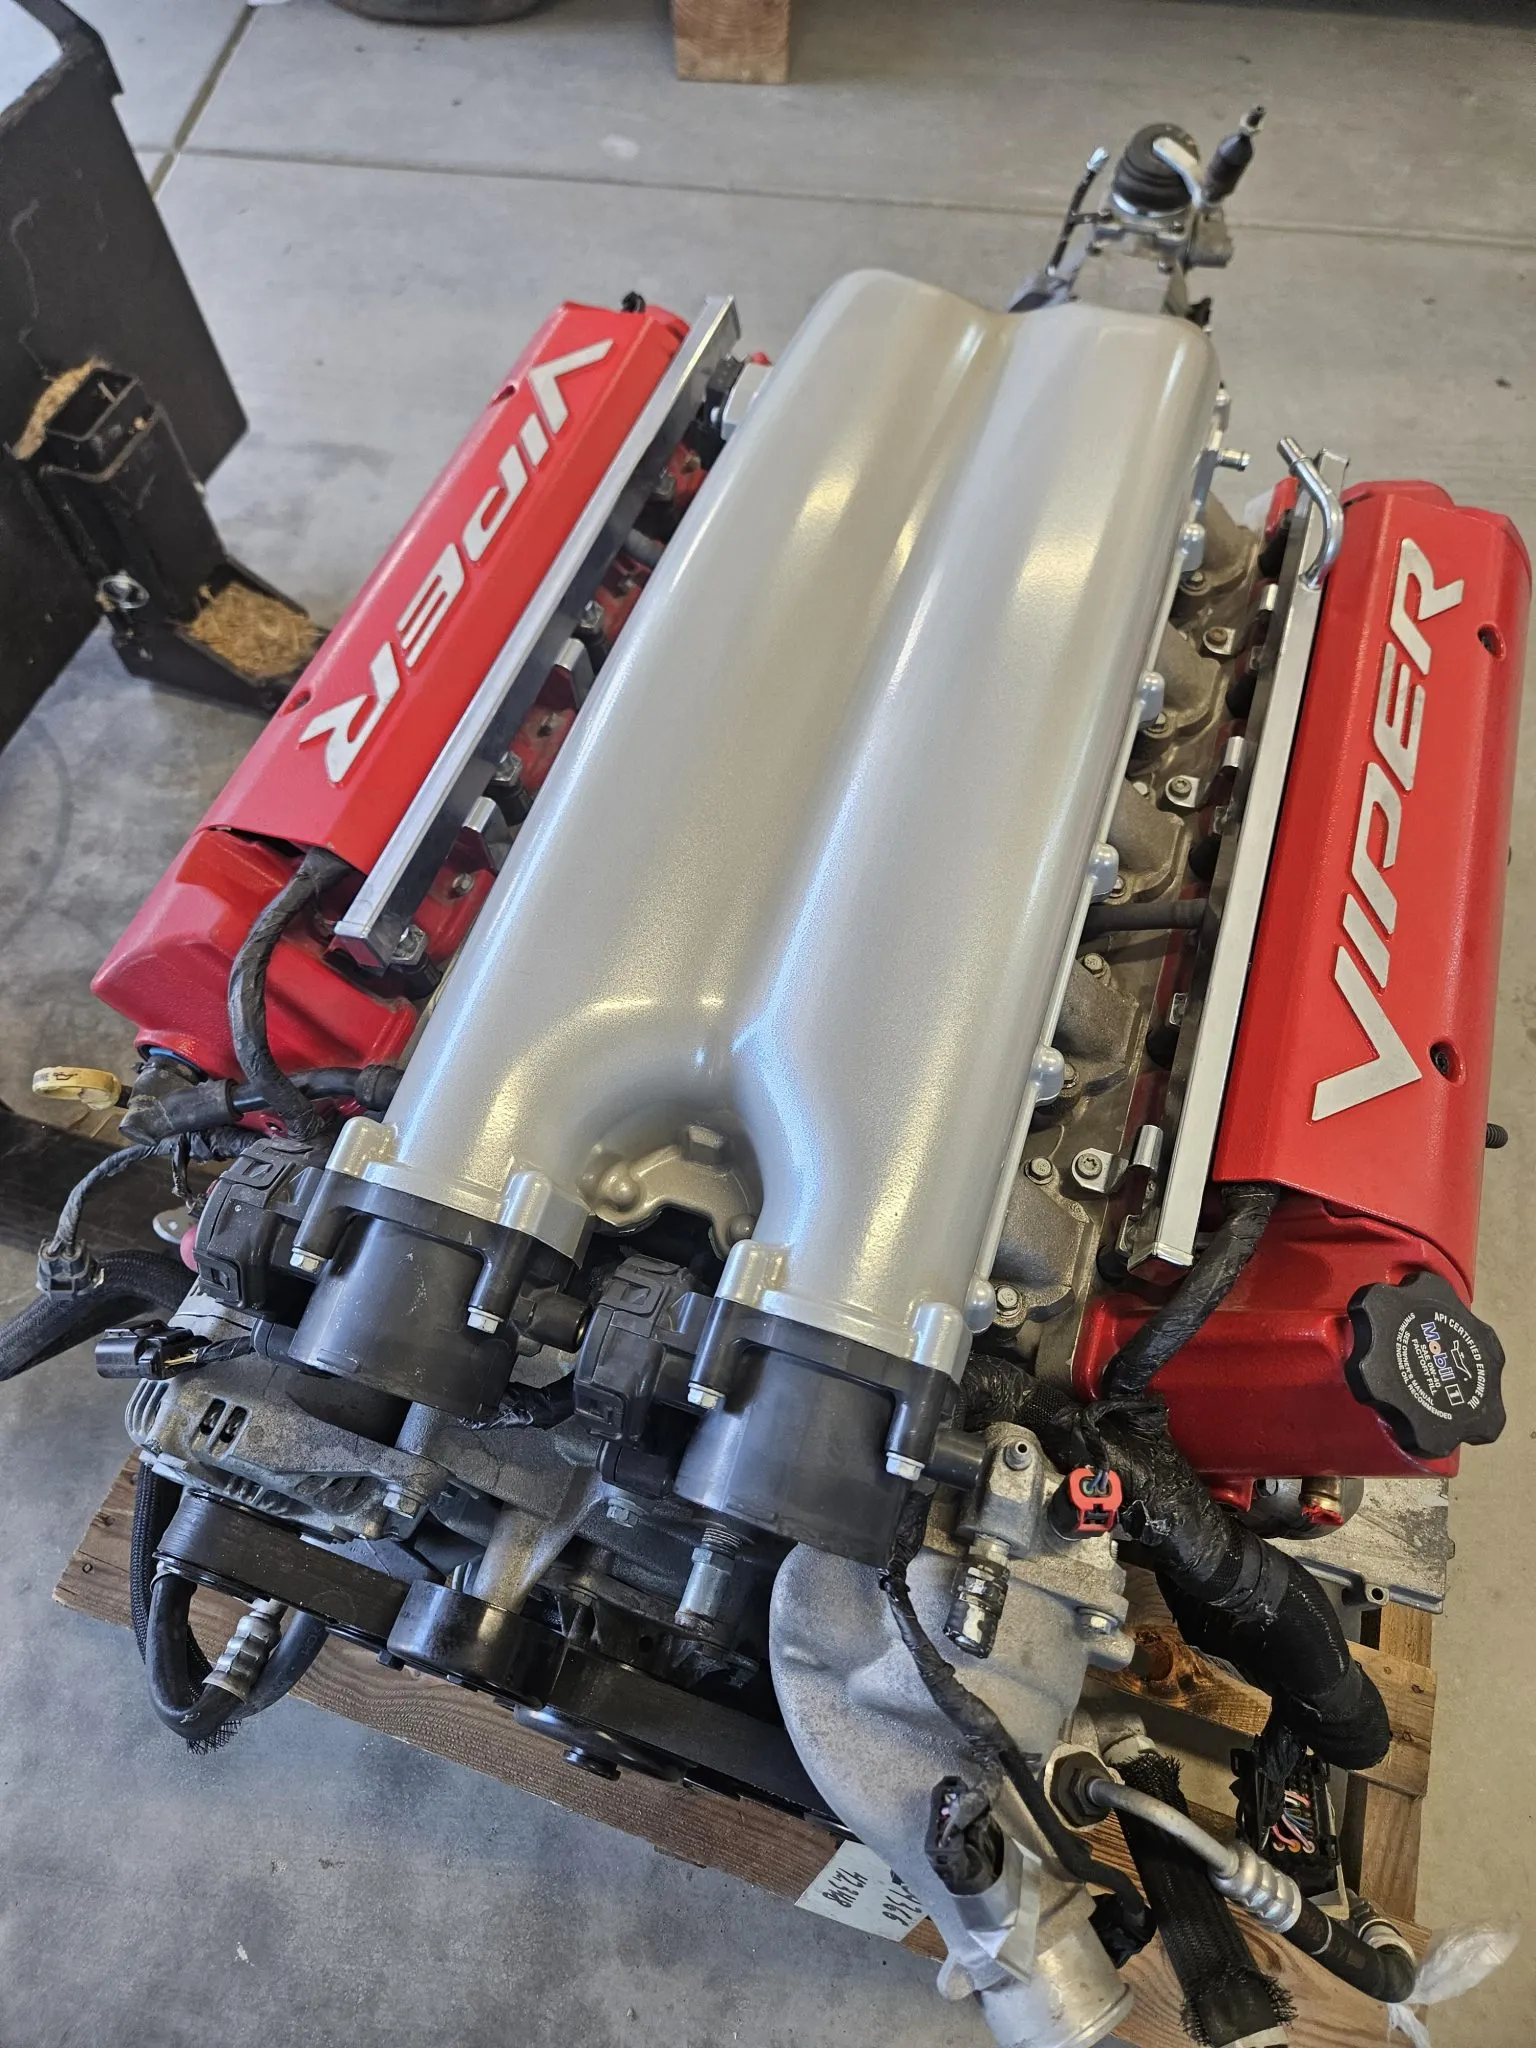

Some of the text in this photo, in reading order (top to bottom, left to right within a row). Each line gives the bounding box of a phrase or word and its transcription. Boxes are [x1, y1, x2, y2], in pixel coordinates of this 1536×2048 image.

[299, 338, 614, 784] VIPER
[1311, 537, 1465, 1122] VIPER
[1396, 1312, 1416, 1342] SYNTHETIC
[1407, 1384, 1453, 1420] RECOMMENDED
[1402, 1331, 1434, 1406] SEE OWNER'S MANUAL
[1412, 1338, 1438, 1396] FACTORY FILL
[1420, 1344, 1441, 1388] SAE 0W-40
[1421, 1321, 1456, 1382] Mobil
[1434, 1312, 1486, 1410] API CERTIFIED ENGINE OIL
